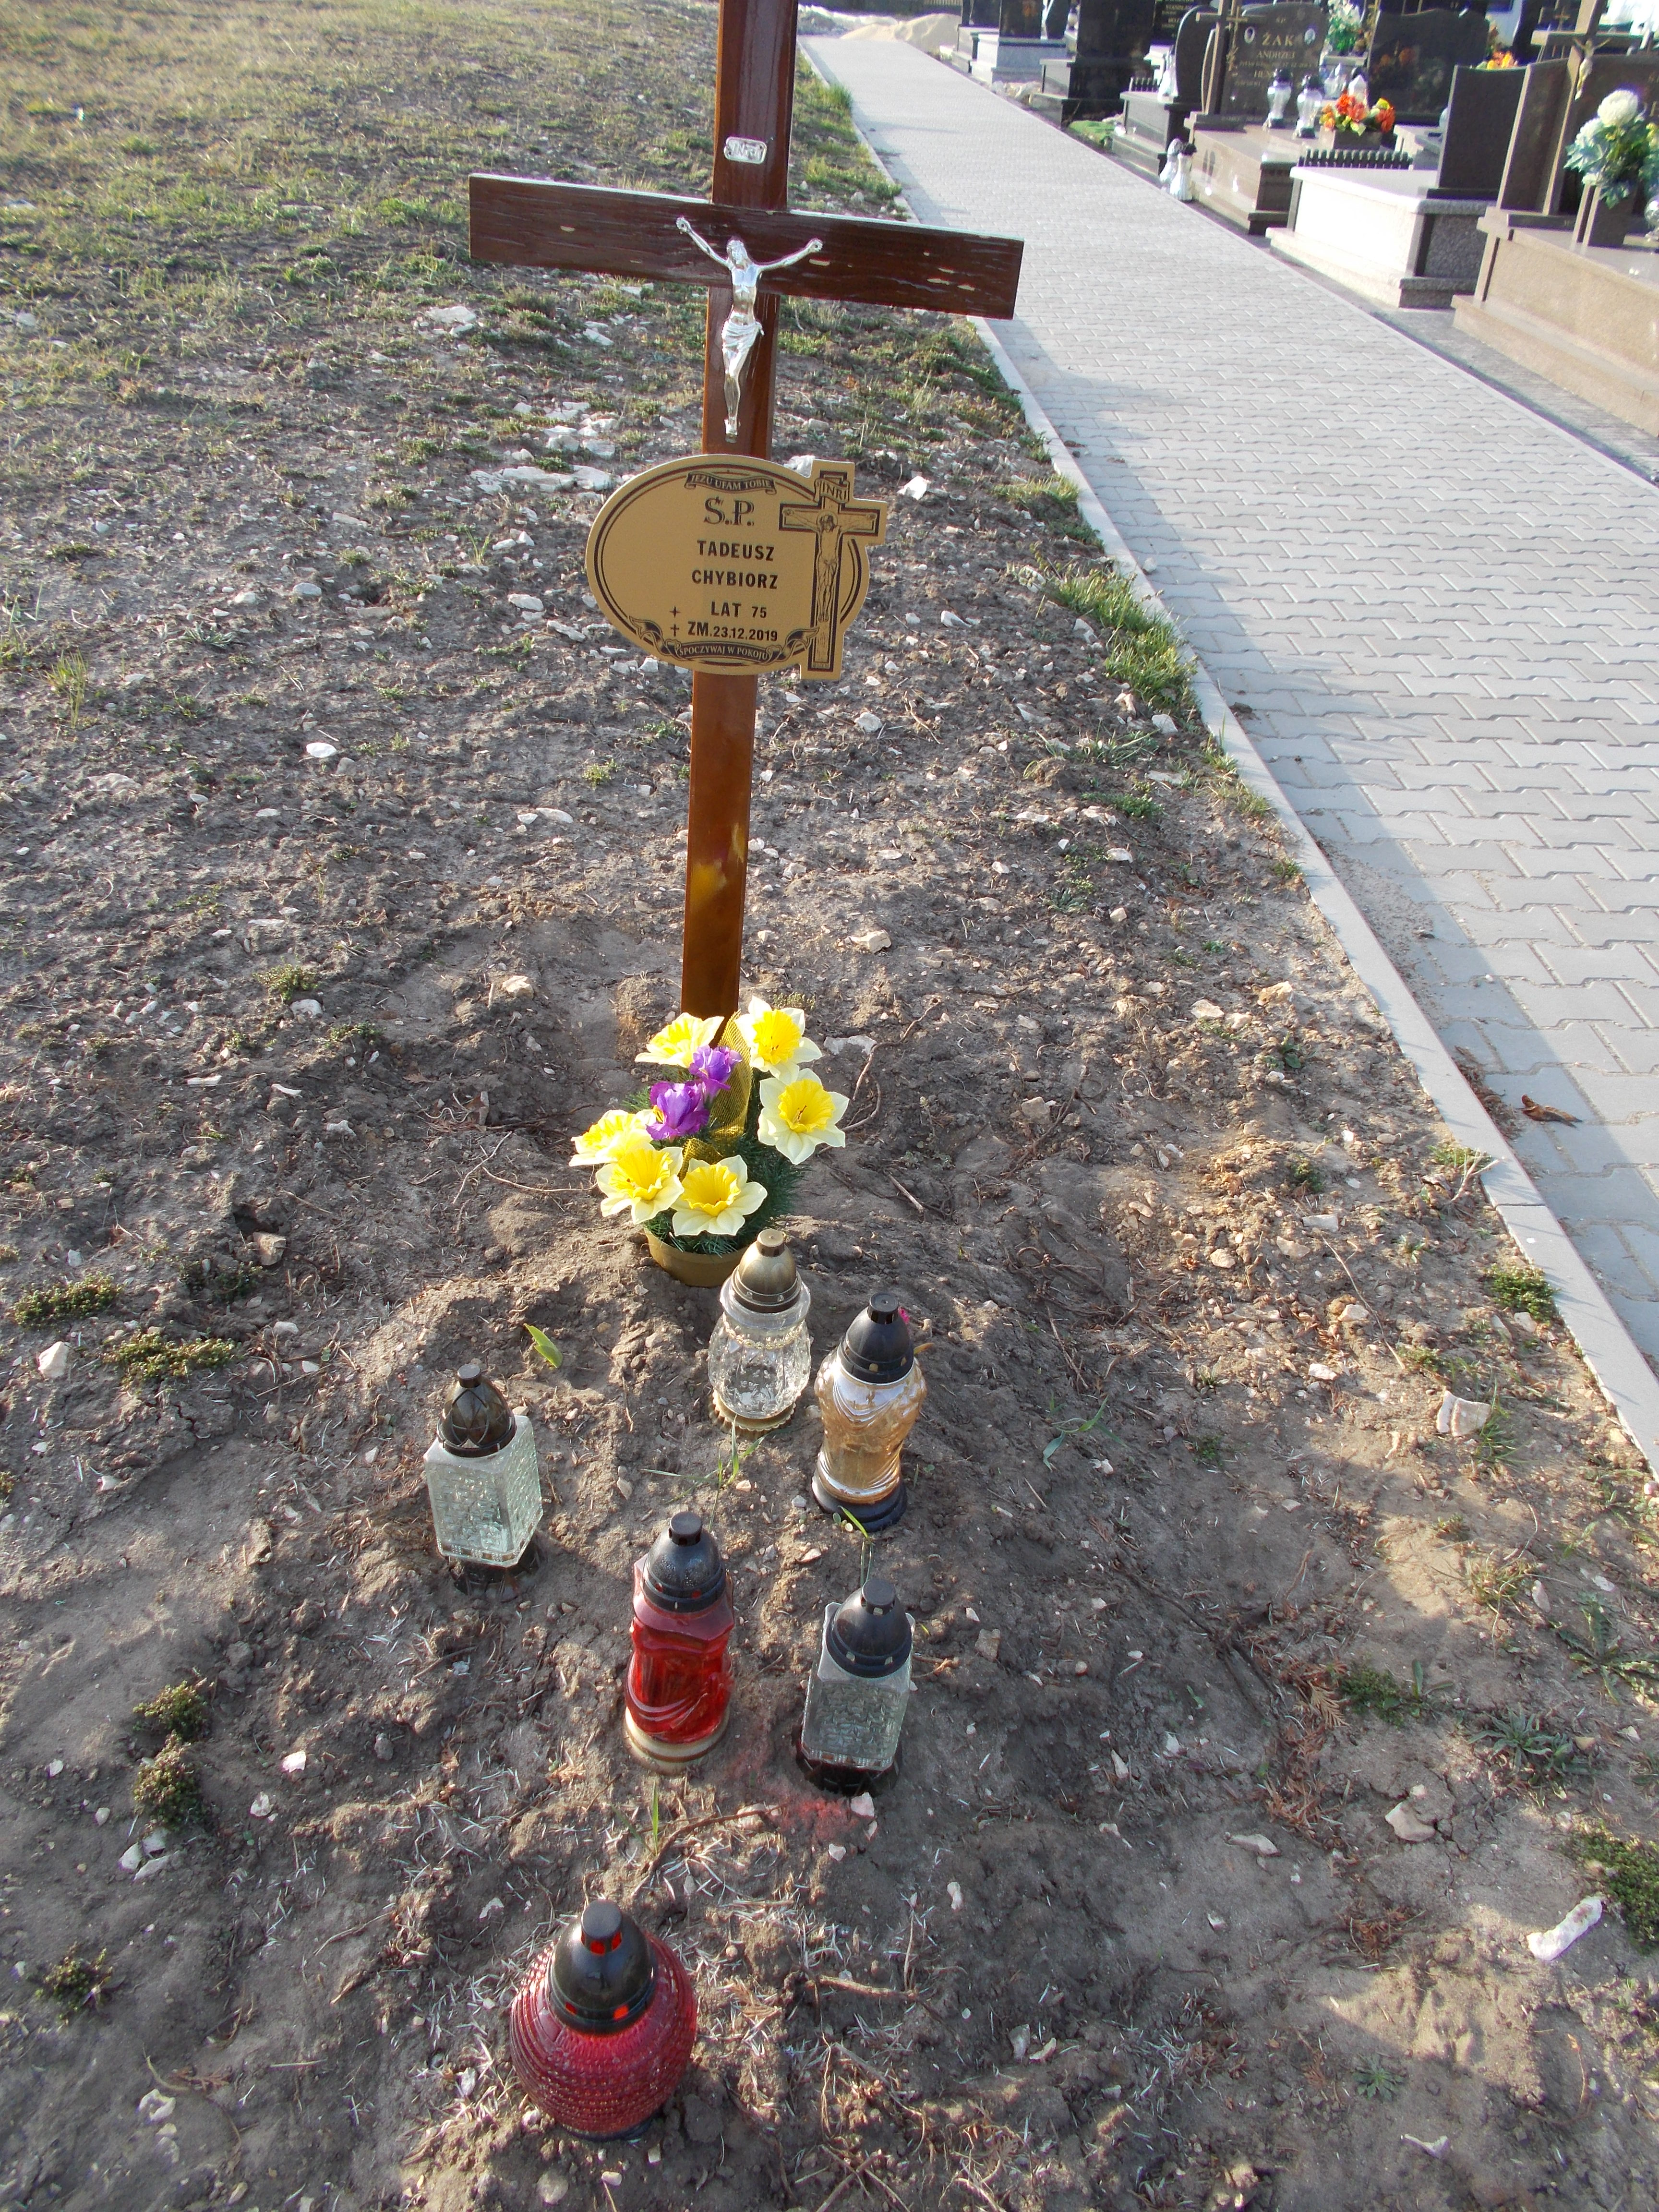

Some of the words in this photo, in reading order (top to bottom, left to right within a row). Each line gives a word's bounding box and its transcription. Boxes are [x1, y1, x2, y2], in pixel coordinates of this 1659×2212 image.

[715, 479, 742, 490] UFAM
[822, 481, 847, 500] INRI
[697, 540, 775, 561] TADEUSZ
[691, 569, 779, 589] CHYBIORZ
[711, 601, 742, 618] LAT
[751, 606, 767, 618] 75
[679, 646, 725, 656] SPOCZYWAJ
[737, 647, 769, 660] POKOJU
